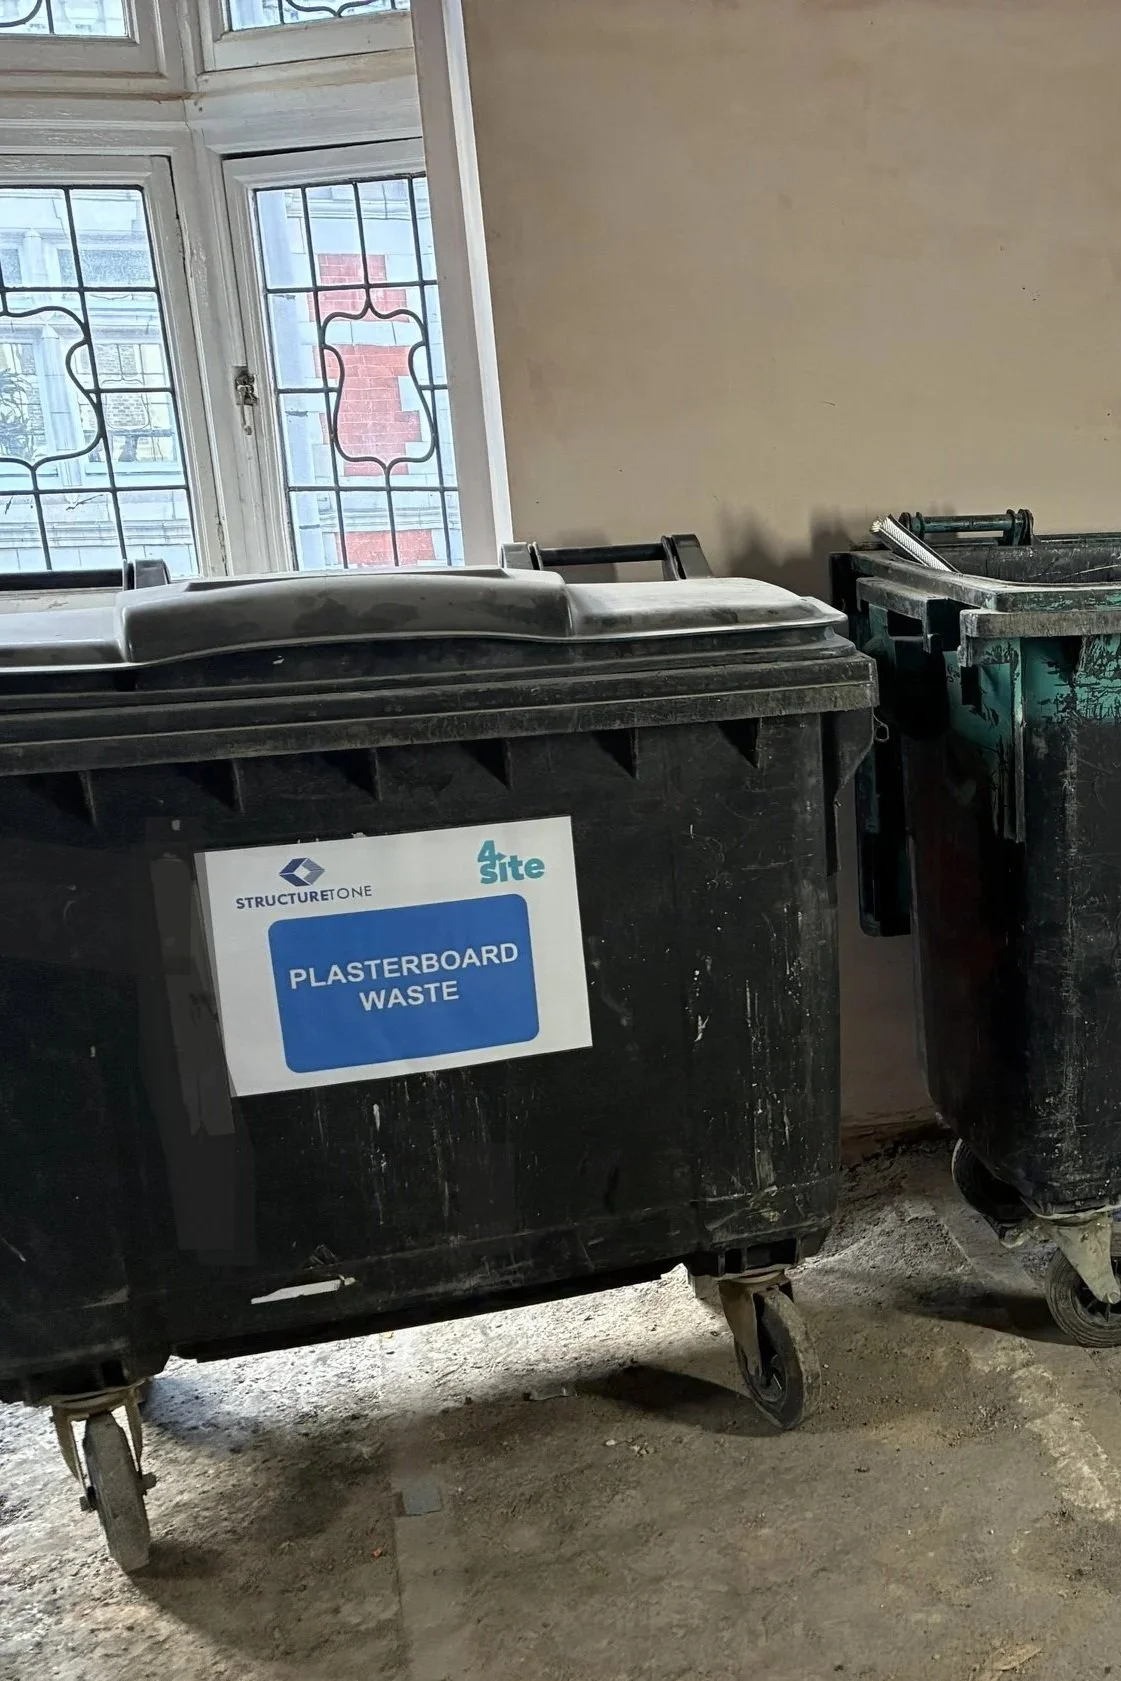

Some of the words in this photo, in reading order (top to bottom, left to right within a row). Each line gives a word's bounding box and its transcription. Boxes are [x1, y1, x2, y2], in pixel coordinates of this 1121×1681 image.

[235, 885, 373, 909] STRUCTURETONE
[289, 942, 519, 990] PLASTERBOARD
[359, 980, 460, 1012] WASTE
